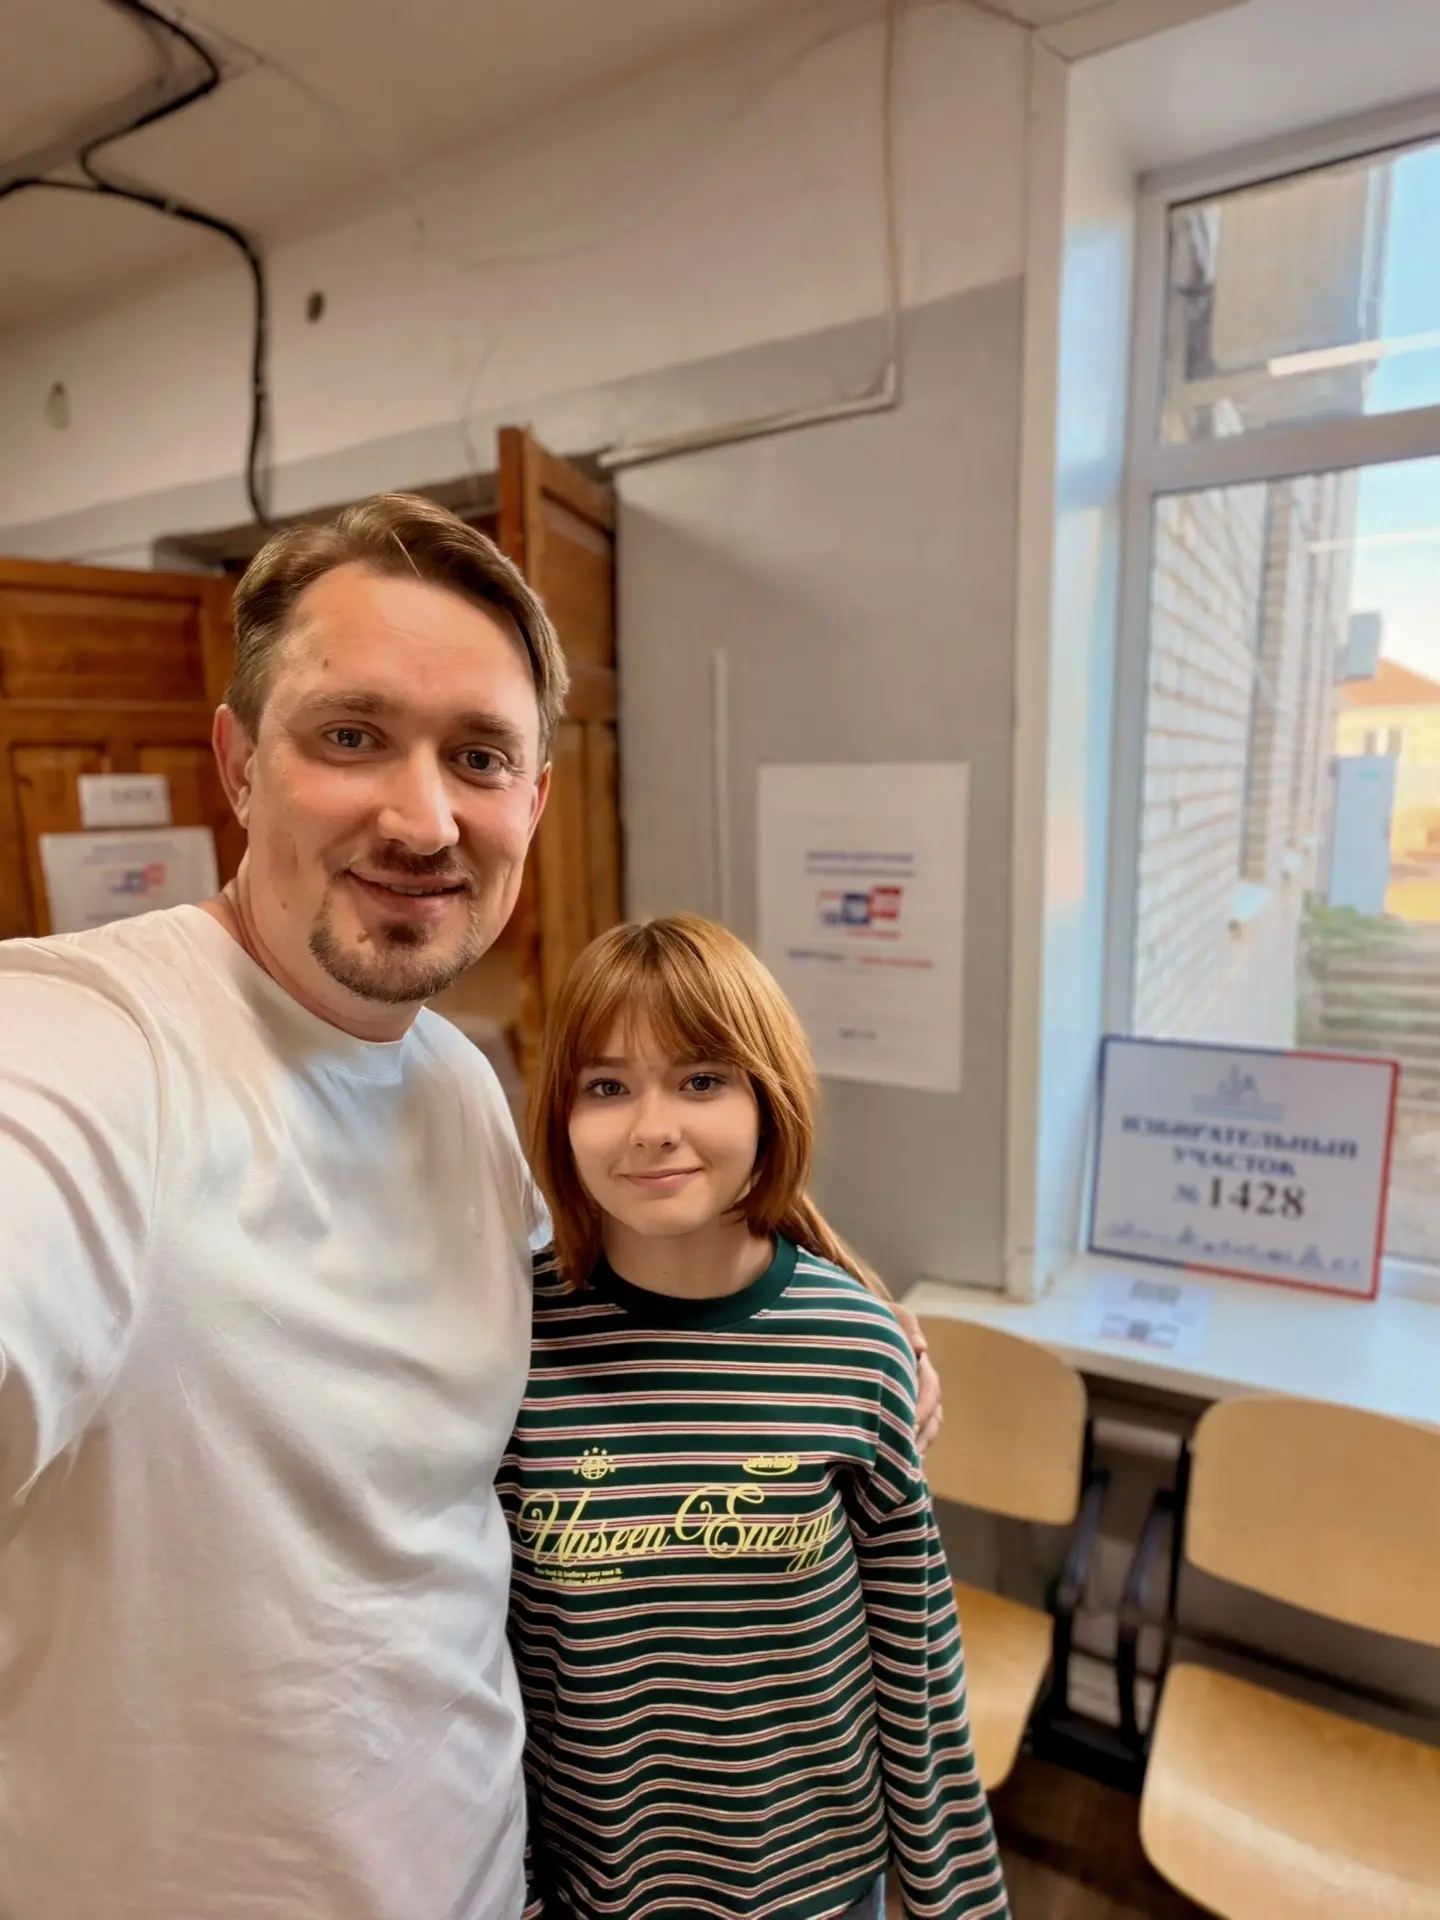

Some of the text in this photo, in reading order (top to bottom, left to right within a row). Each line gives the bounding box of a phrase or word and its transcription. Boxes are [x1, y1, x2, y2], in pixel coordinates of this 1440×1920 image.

[1172, 1146, 1296, 1178] УЧАСТОК
[1209, 1175, 1306, 1220] 1428
[516, 1484, 834, 1573] Unseen Energy
